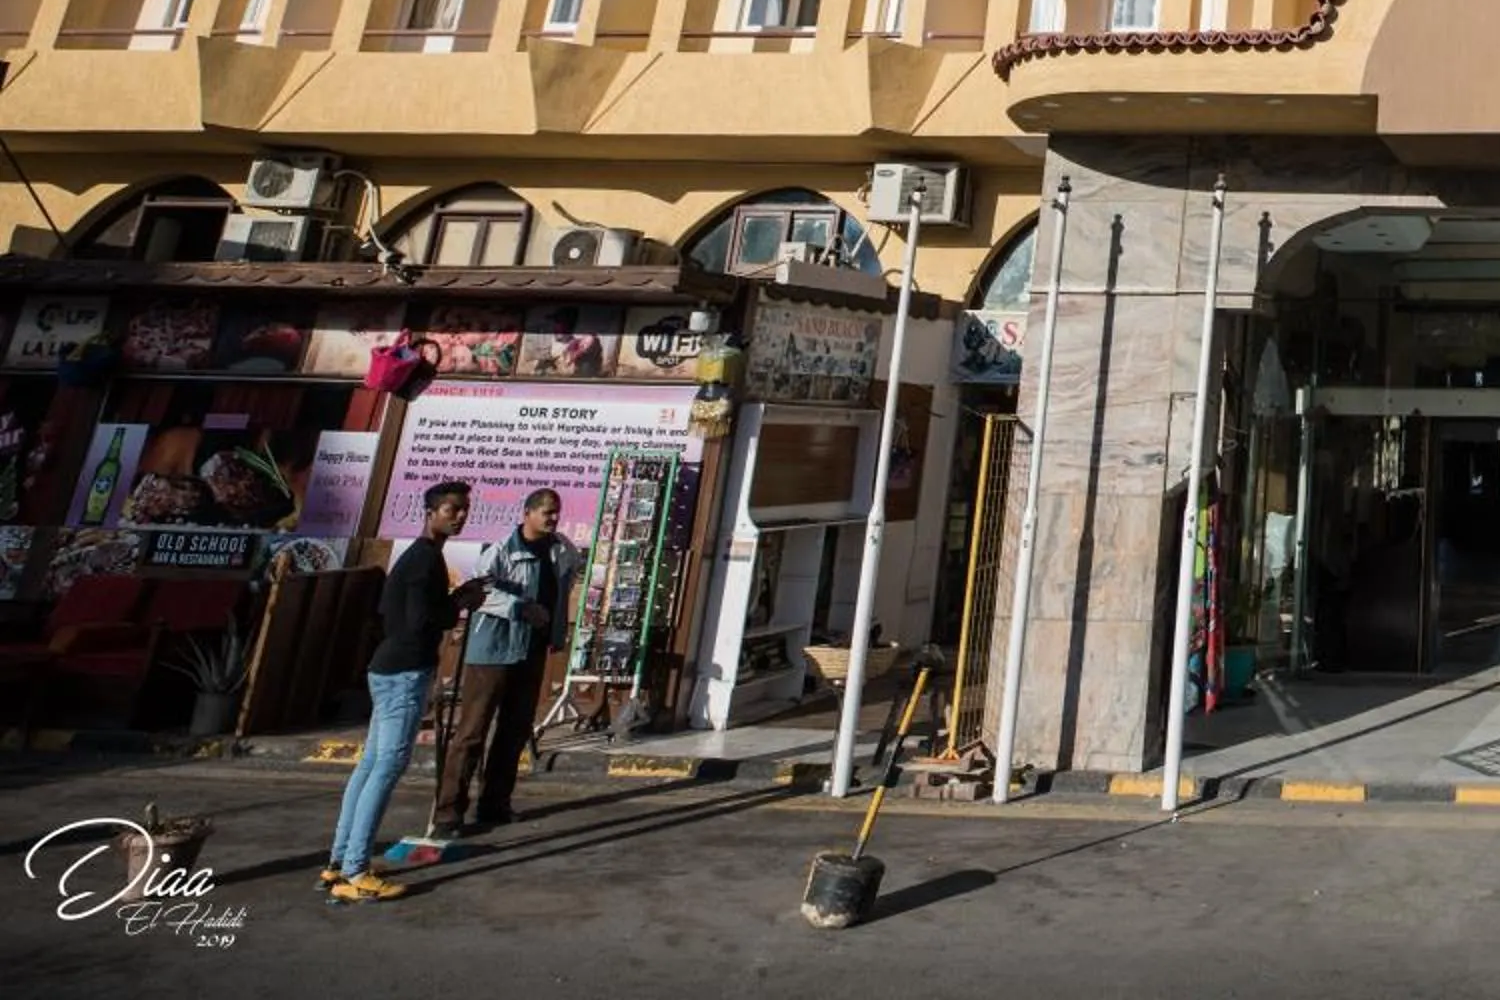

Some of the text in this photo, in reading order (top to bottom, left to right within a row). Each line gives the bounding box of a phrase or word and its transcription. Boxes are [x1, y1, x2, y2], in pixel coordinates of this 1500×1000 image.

[519, 407, 549, 419] OUR
[552, 408, 598, 420] STORY
[157, 533, 248, 553] OLD SCHOOL
